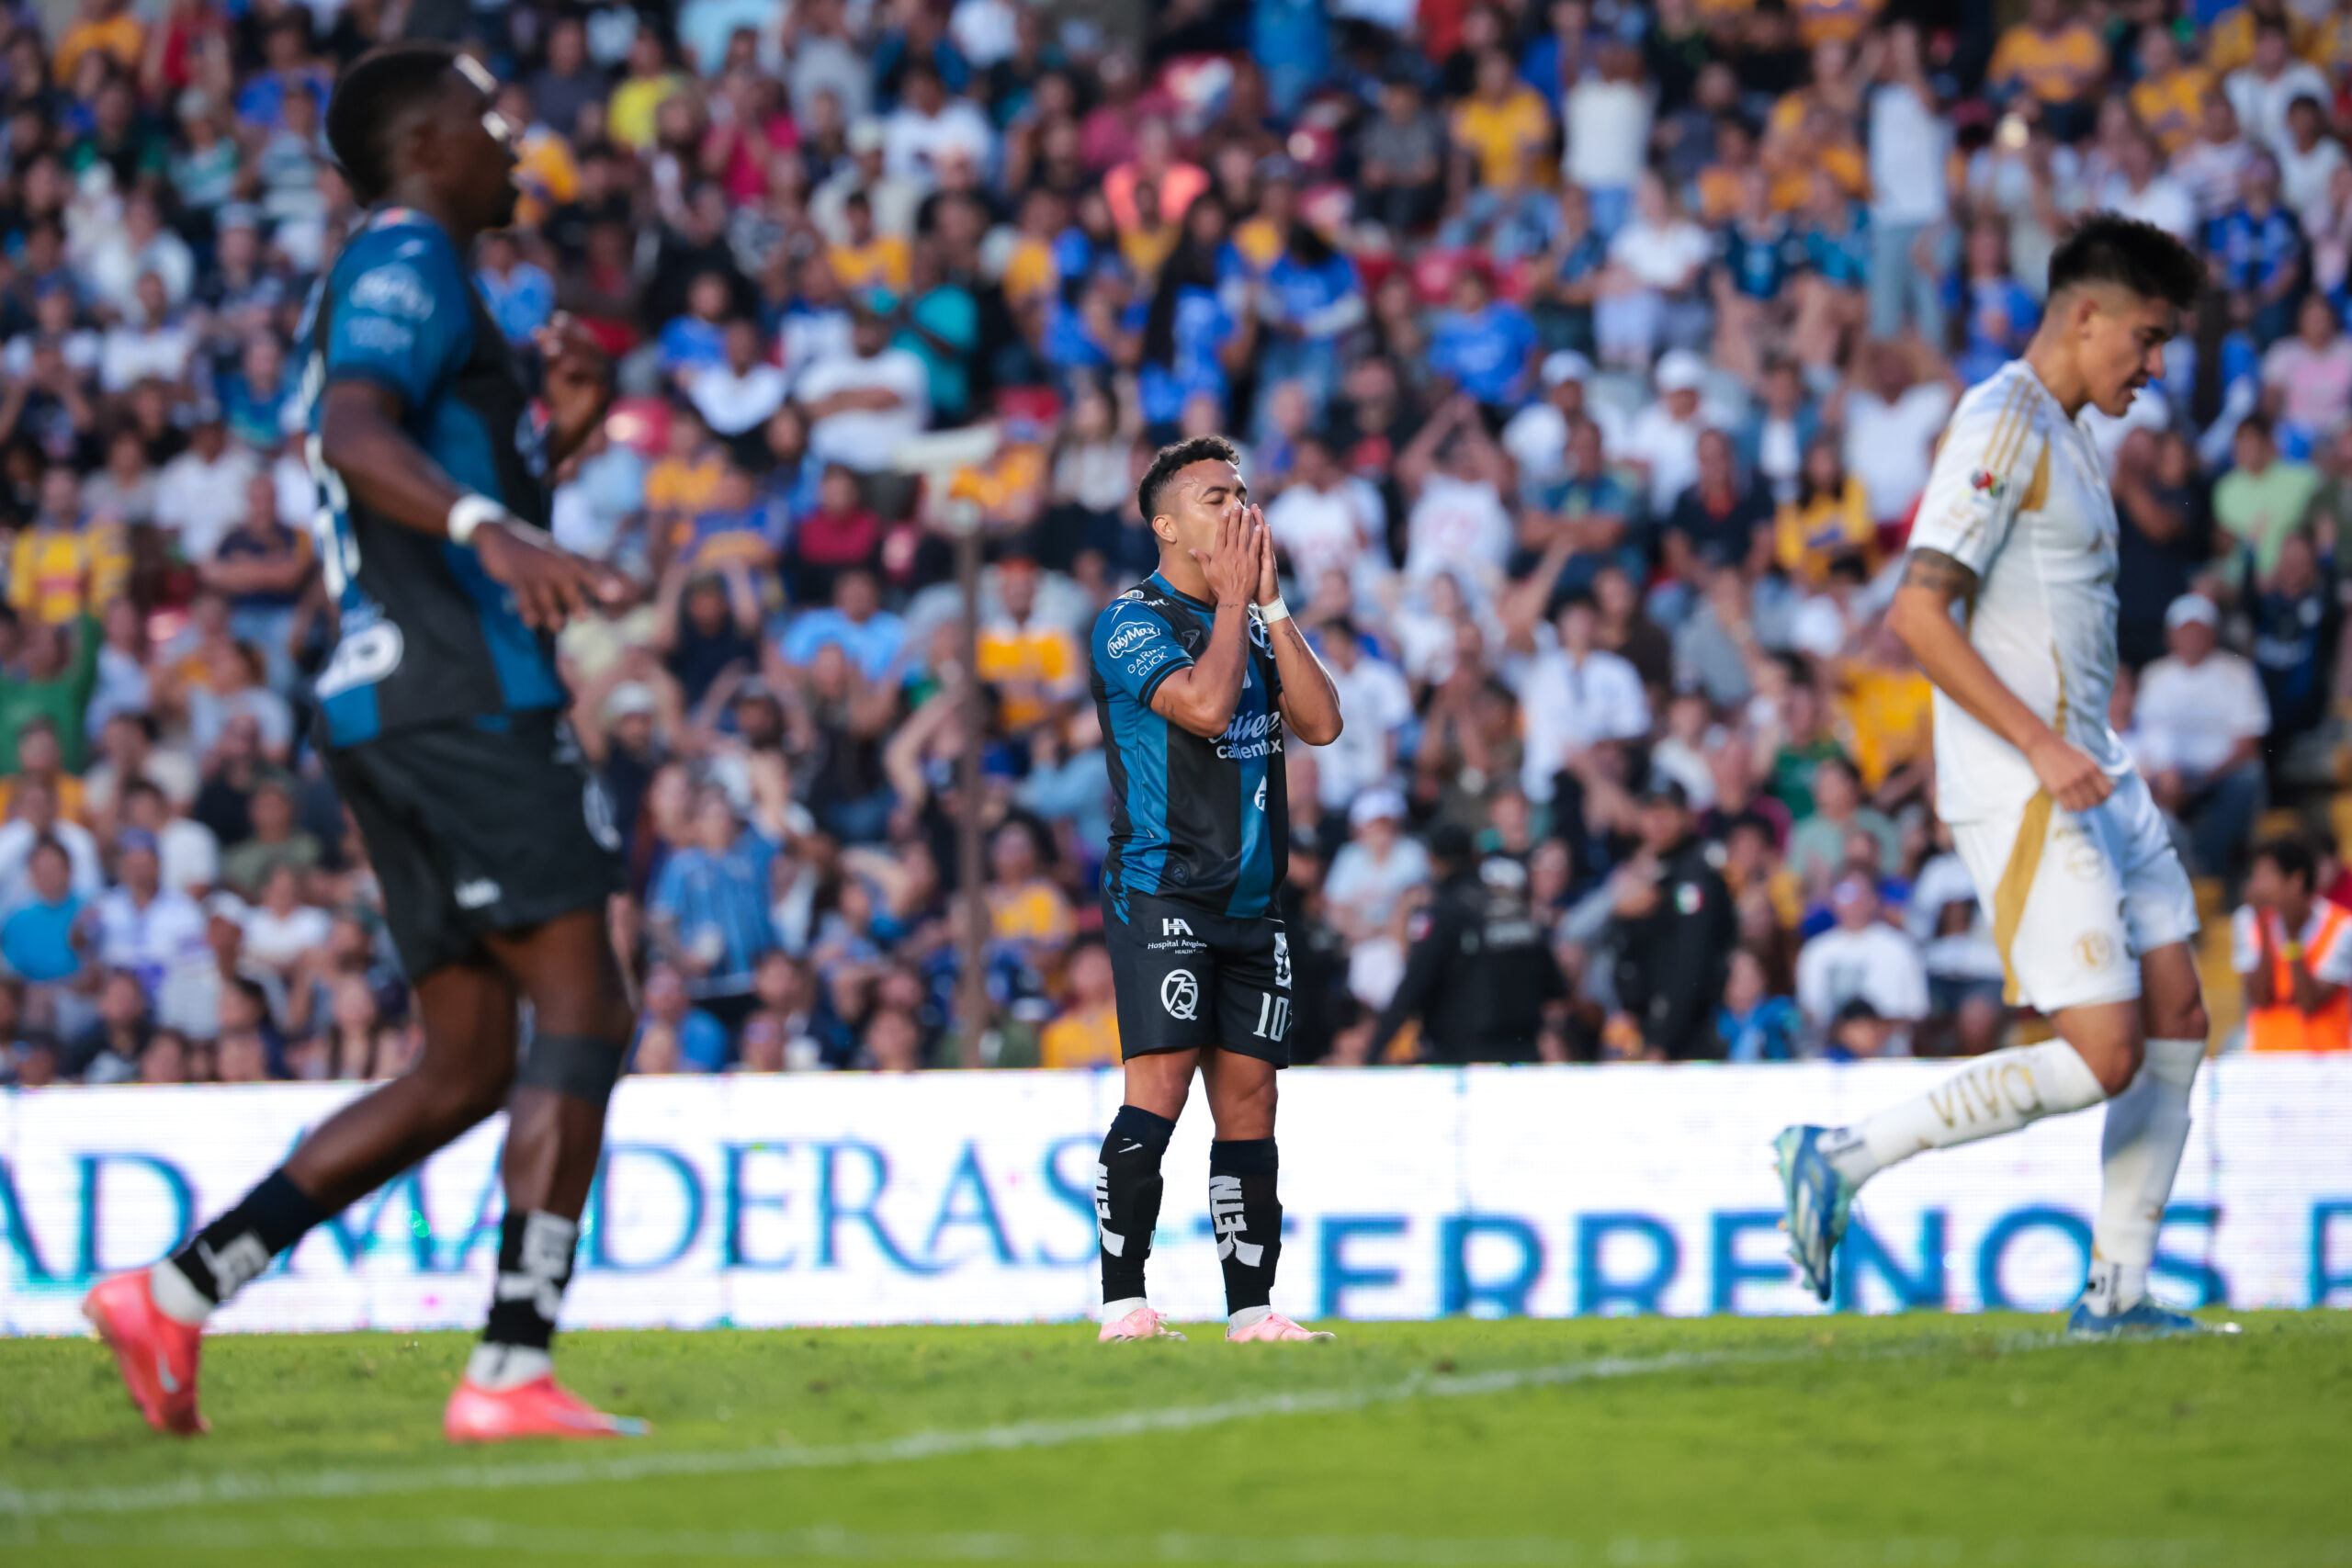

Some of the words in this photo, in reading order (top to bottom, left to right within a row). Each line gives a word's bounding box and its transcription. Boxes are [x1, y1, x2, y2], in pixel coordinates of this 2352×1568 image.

[1109, 626, 1157, 655] PolyMax
[1137, 651, 1169, 677] CLICK
[1148, 939, 1179, 950] Hospital
[1252, 992, 1289, 1043] 10
